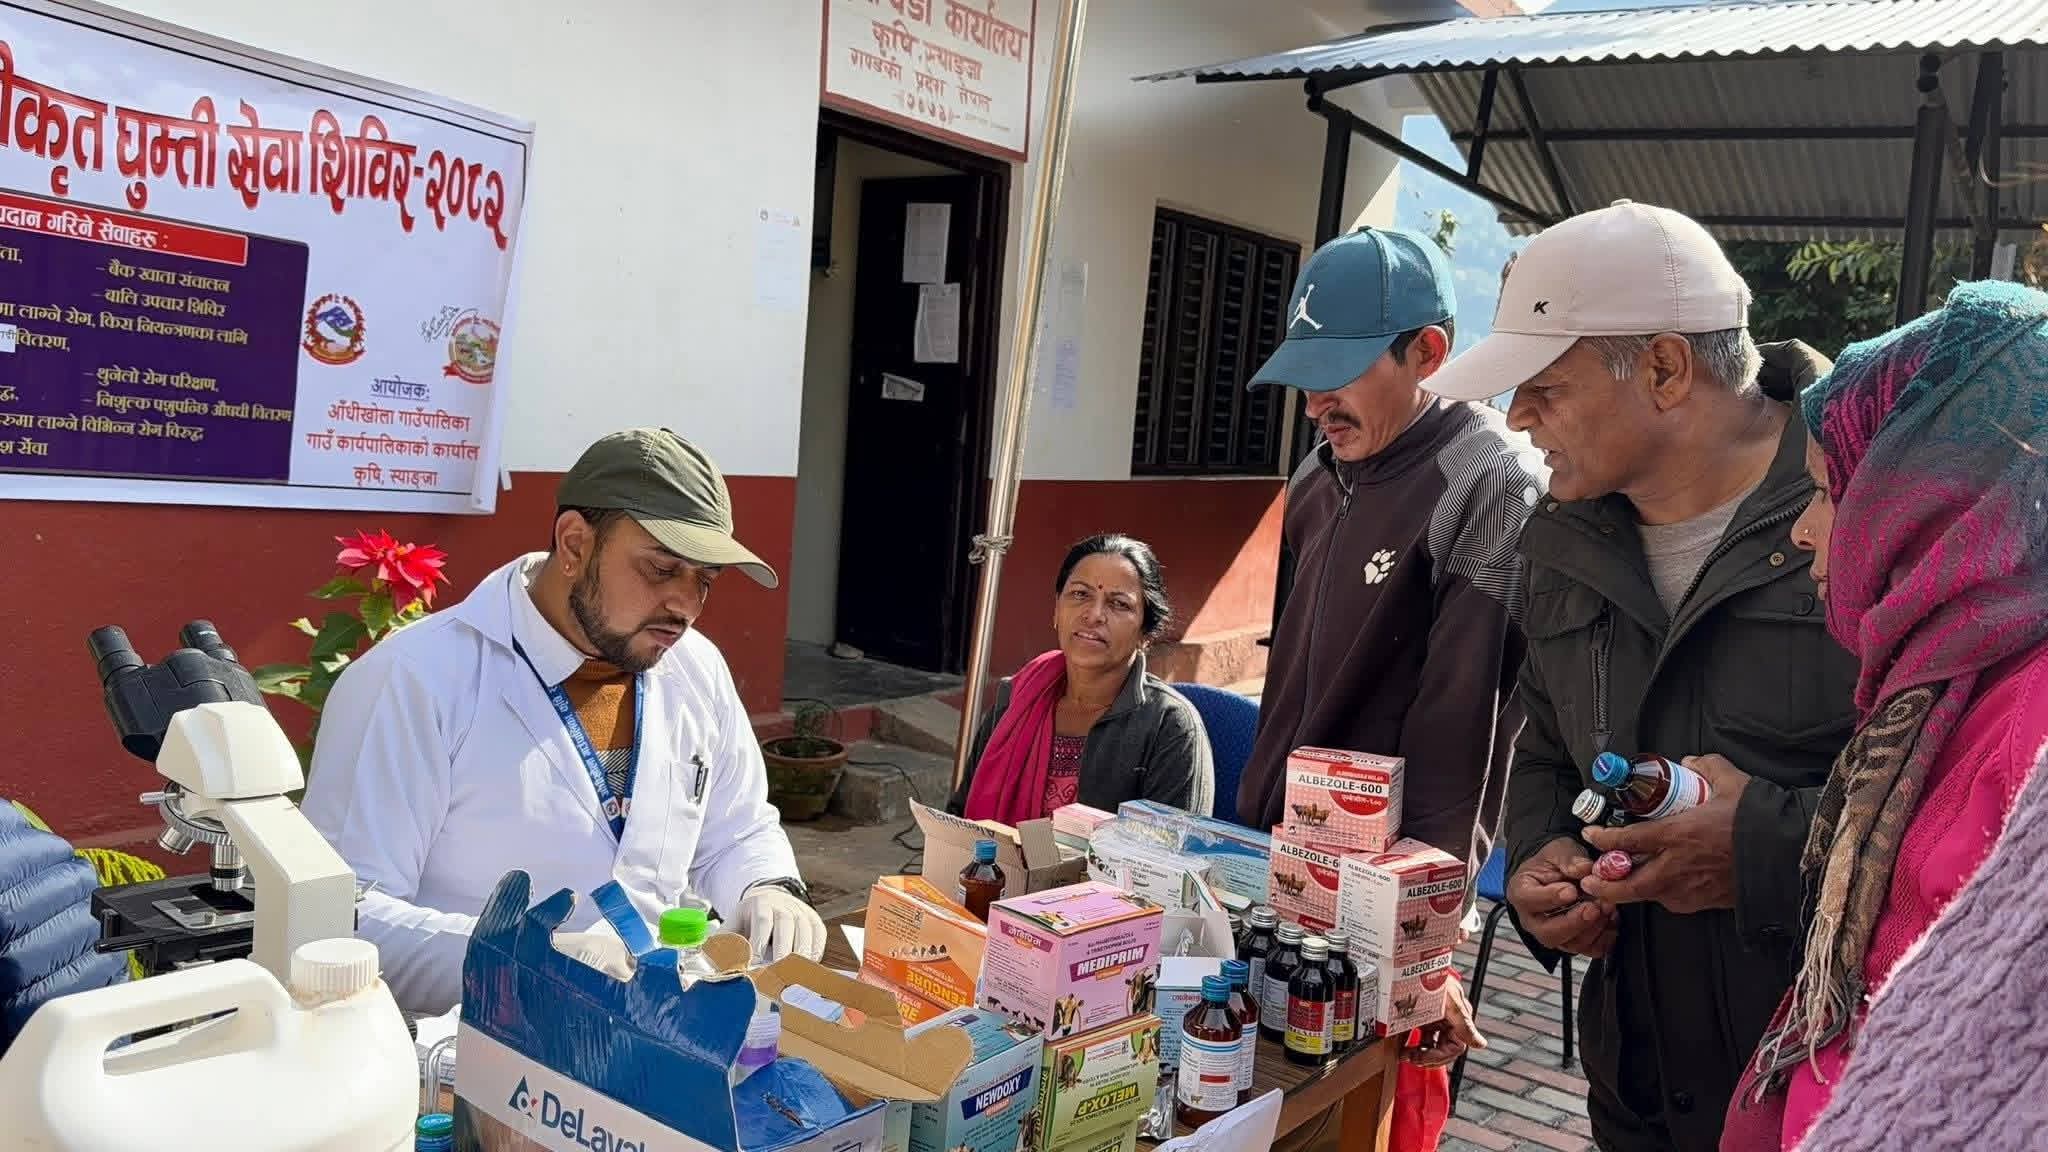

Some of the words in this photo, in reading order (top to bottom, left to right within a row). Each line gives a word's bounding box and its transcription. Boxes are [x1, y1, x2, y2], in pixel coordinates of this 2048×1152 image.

[0, 39, 108, 196] ीकृत
[115, 94, 219, 210] घुम्ती
[226, 97, 303, 210] सेवा
[46, 210, 94, 238] गरिने
[138, 266, 176, 286] खाता
[187, 297, 226, 318] शिविर
[18, 303, 62, 323] लाग्ने
[217, 327, 248, 345] लागि
[142, 367, 168, 386] रोग
[0, 413, 34, 429] रुमा
[81, 414, 137, 435] विभिन्न
[138, 418, 162, 437] रोग
[166, 421, 204, 442] विरुद्ध
[327, 399, 395, 425] आँधीखोला
[398, 406, 471, 432] गाउँपालिका
[306, 428, 335, 450] गाउँ
[336, 432, 430, 458] कार्यपालिकाको
[431, 440, 481, 461] कार्याल
[1299, 773, 1383, 795] ALBEZOLE-600
[1280, 843, 1340, 868] ALBEZOLE-6
[1406, 880, 1464, 898] ALBEZOLE-600
[1076, 946, 1144, 977] MEDIPRIM
[975, 1074, 1022, 1112] NEWDOXY
[541, 1090, 645, 1152] DeLav
